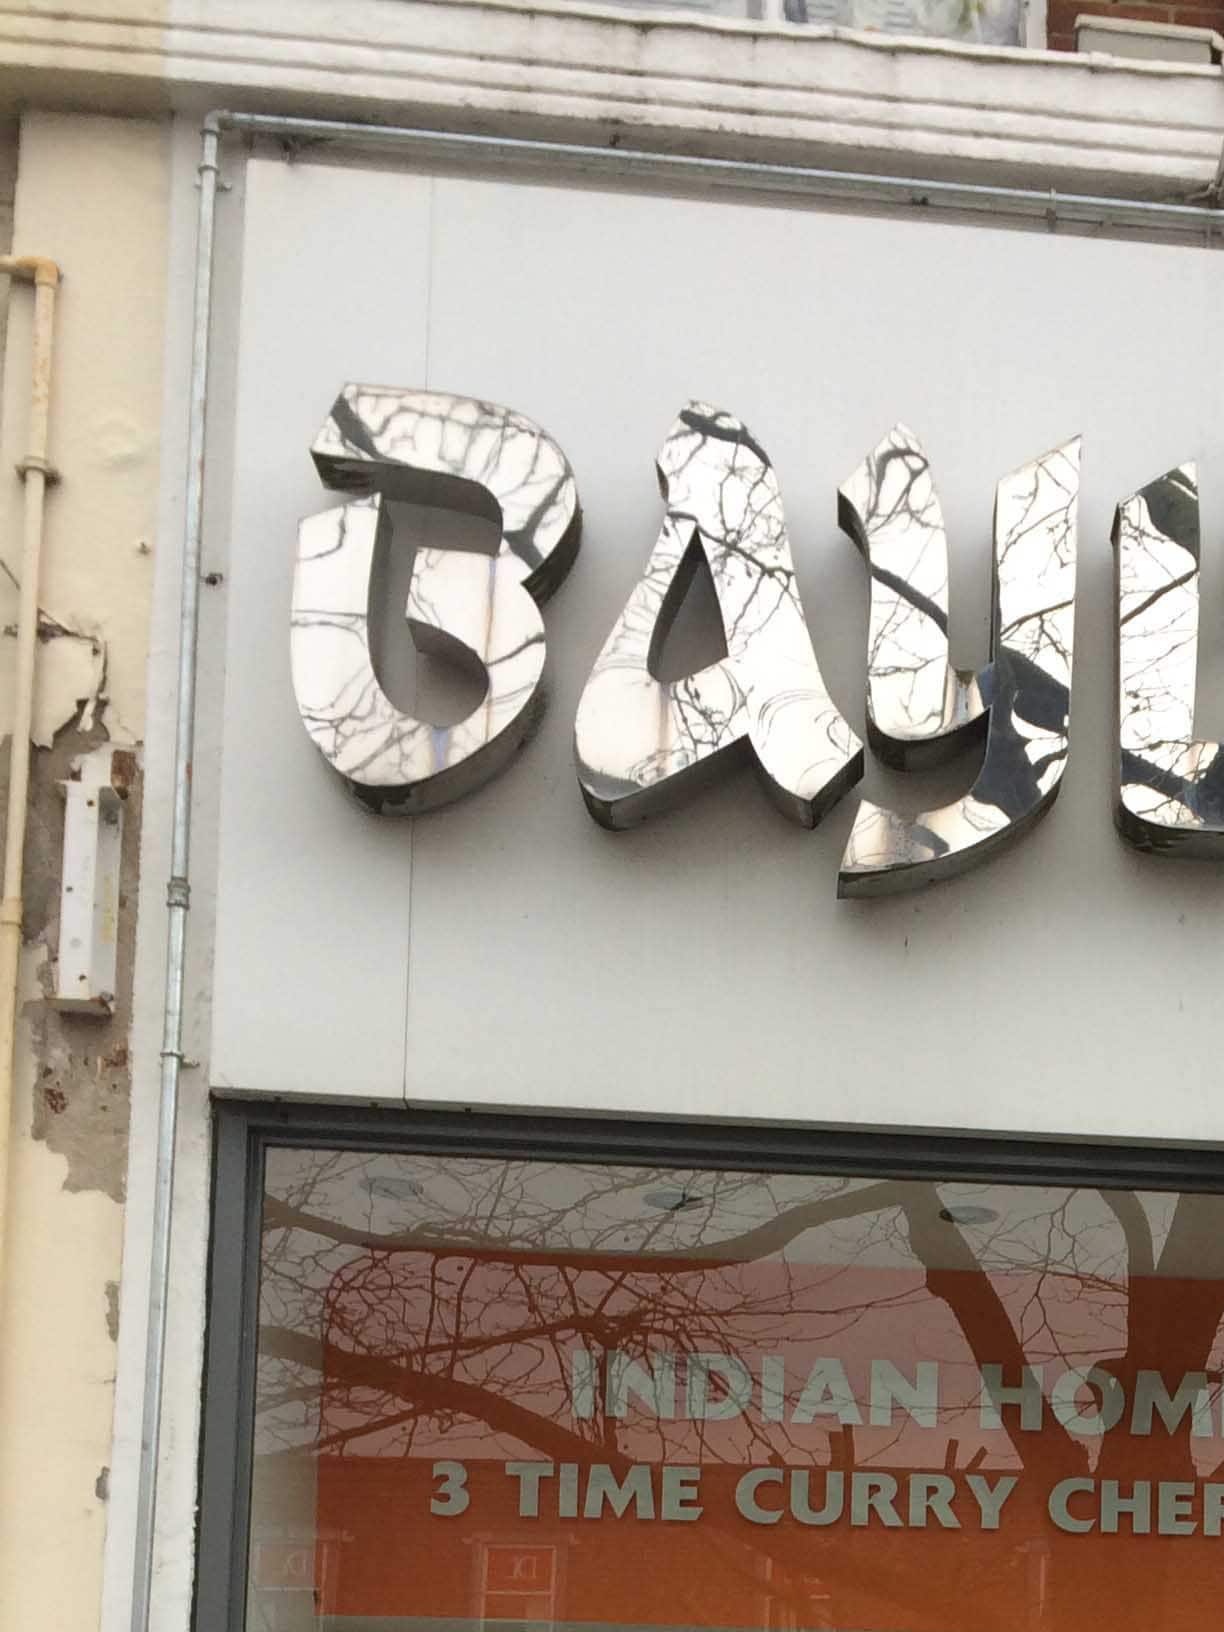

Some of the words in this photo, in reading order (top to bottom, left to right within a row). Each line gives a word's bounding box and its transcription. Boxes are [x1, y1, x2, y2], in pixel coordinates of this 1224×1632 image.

[572, 1350, 937, 1427] INDIAN
[430, 1460, 470, 1517] 3
[505, 1462, 704, 1521] TIME
[736, 1467, 1024, 1530] CURRY
